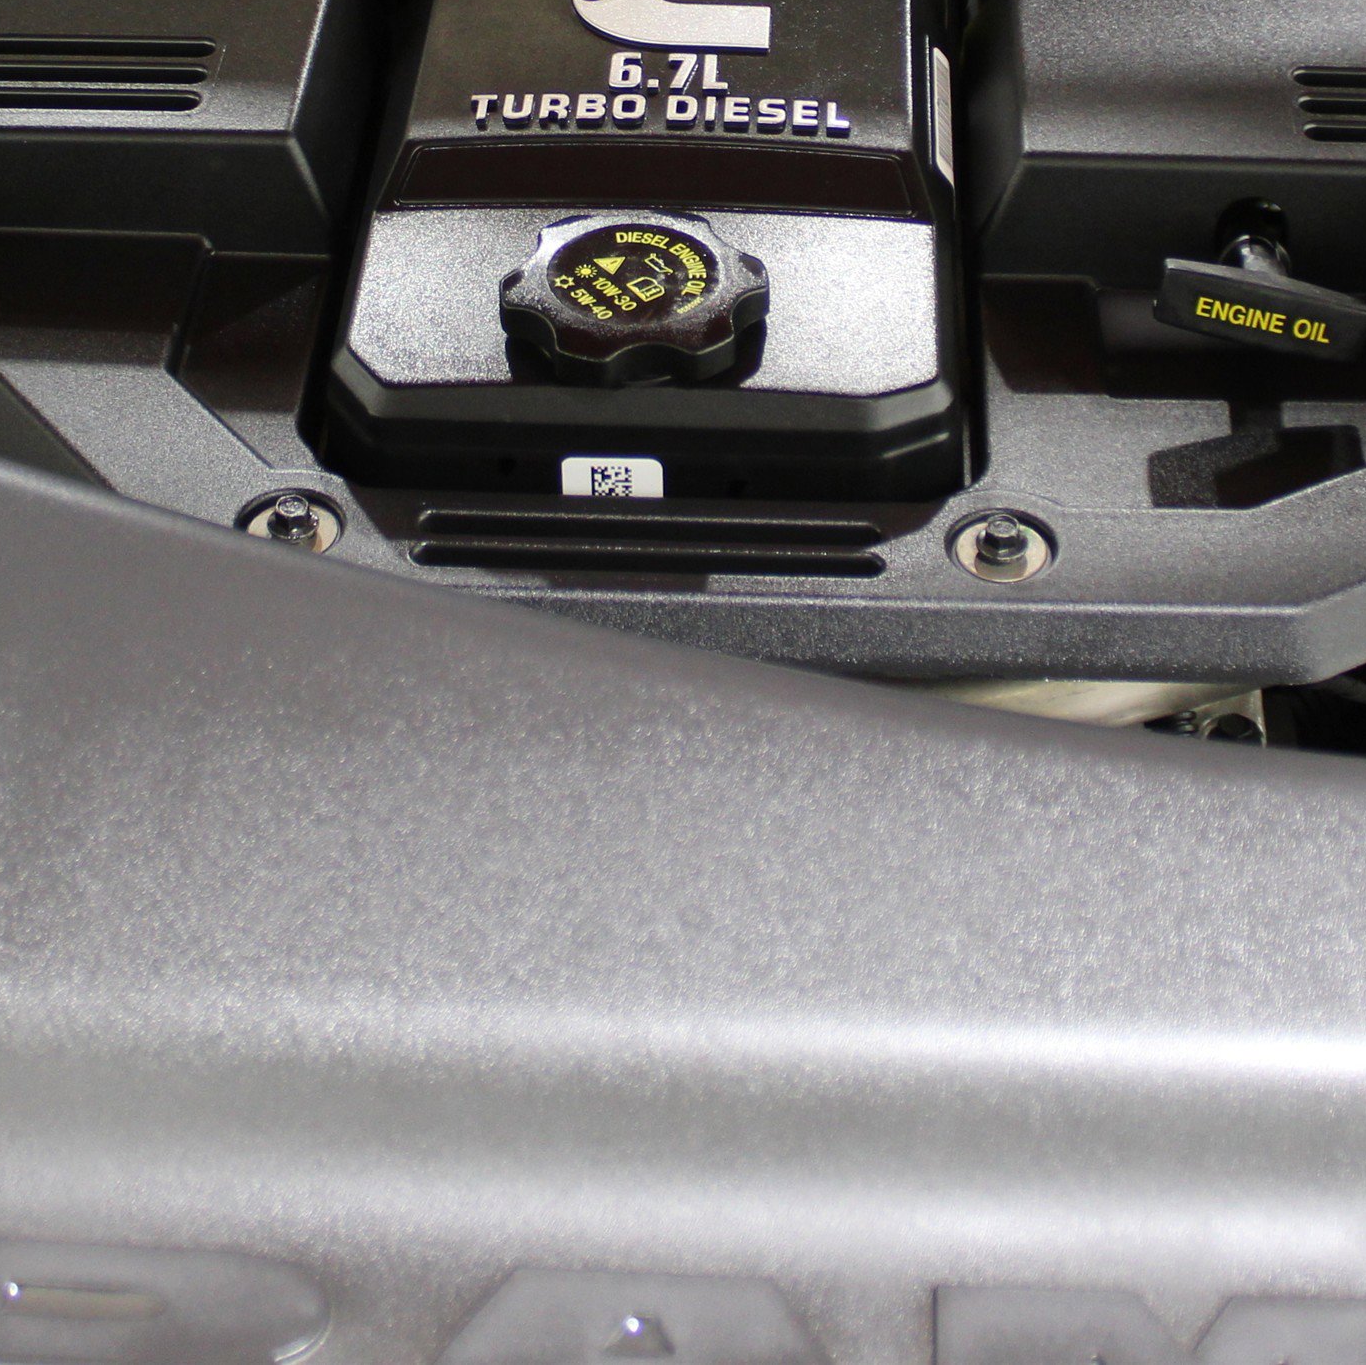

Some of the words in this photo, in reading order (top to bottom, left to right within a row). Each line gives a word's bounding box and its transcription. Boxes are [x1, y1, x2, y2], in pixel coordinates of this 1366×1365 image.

[607, 51, 729, 94] 6.7L
[471, 93, 645, 129] TURBO
[665, 96, 851, 135] DIESEL
[615, 232, 670, 249] DIESEL
[669, 243, 707, 279] ENGINE
[570, 288, 613, 320] 5W-40
[592, 277, 638, 312] 10W-30
[681, 280, 706, 296] OIL
[1195, 296, 1285, 334] ENGINE
[1292, 316, 1331, 345] OIL
